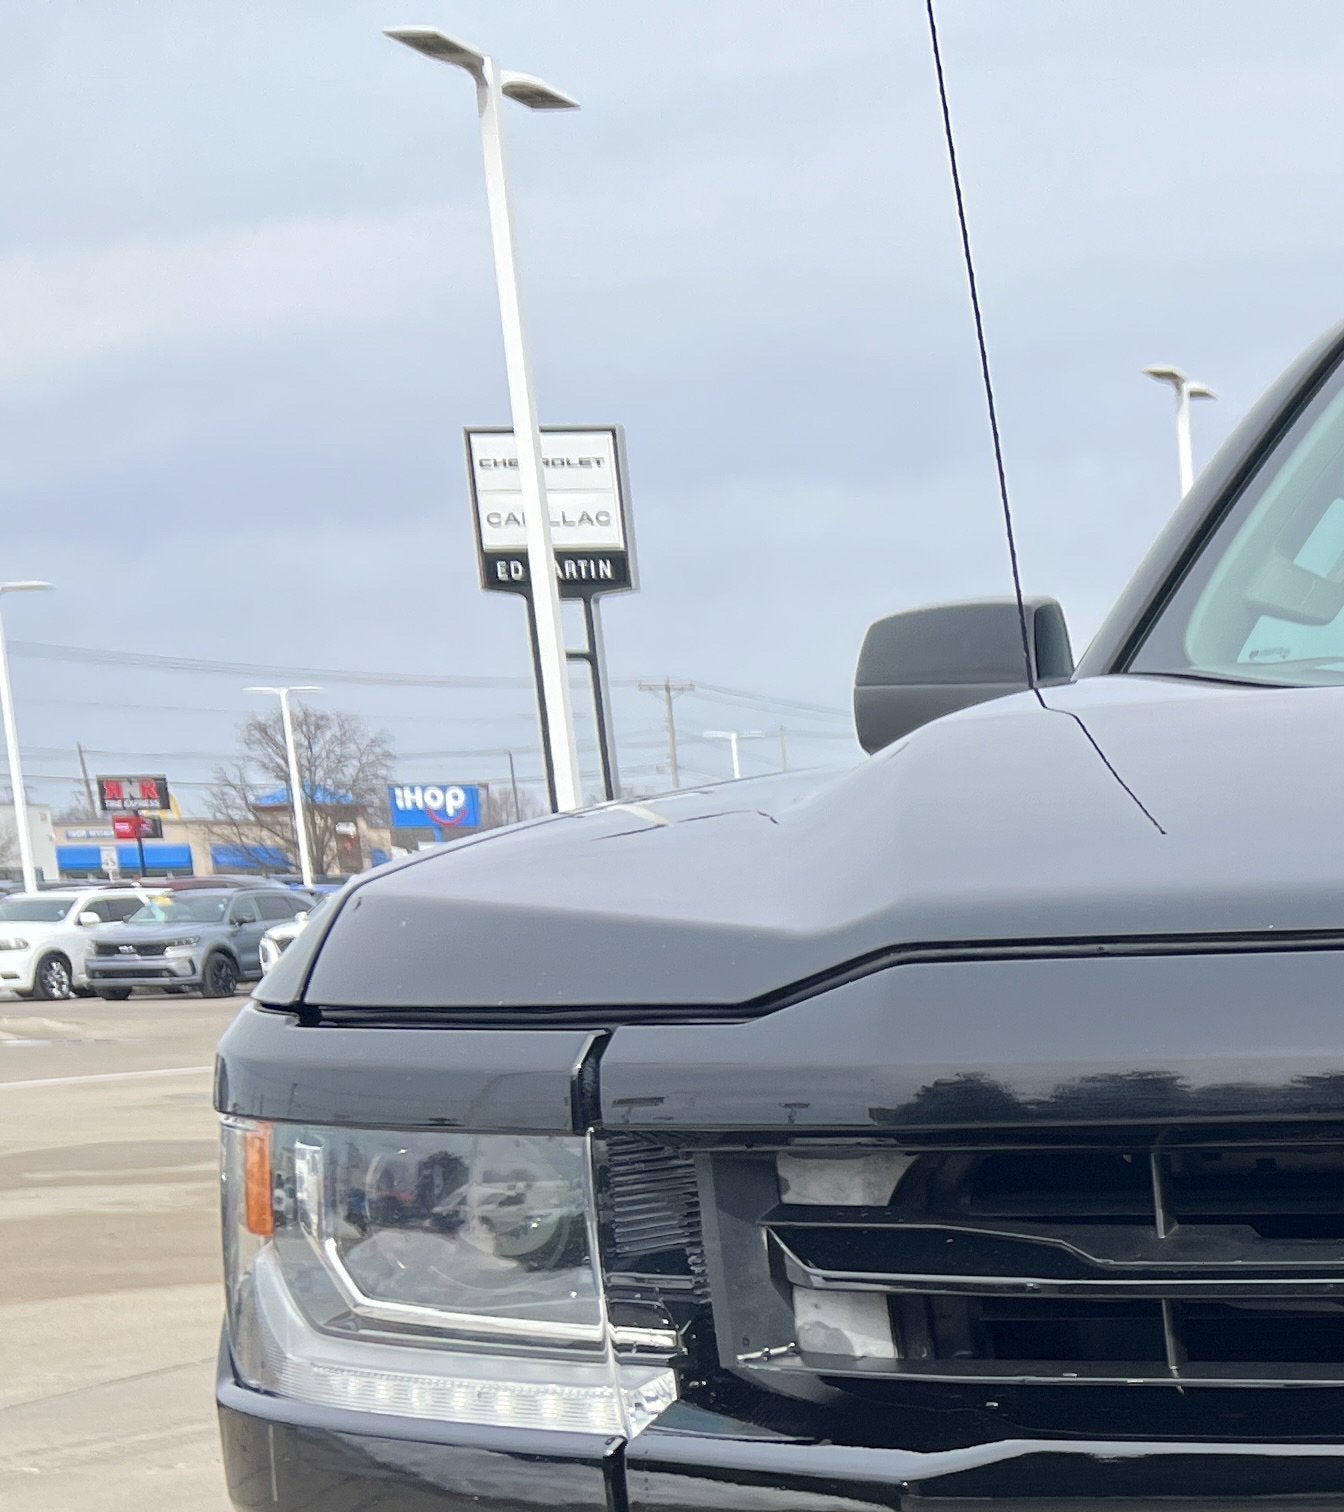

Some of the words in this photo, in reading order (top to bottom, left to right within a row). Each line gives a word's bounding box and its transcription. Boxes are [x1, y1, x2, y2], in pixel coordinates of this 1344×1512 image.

[478, 456, 605, 469] CHEROLET
[486, 510, 611, 528] CALAC
[496, 560, 524, 581] ED
[553, 559, 616, 580] RTIN
[394, 786, 466, 817] IHOP
